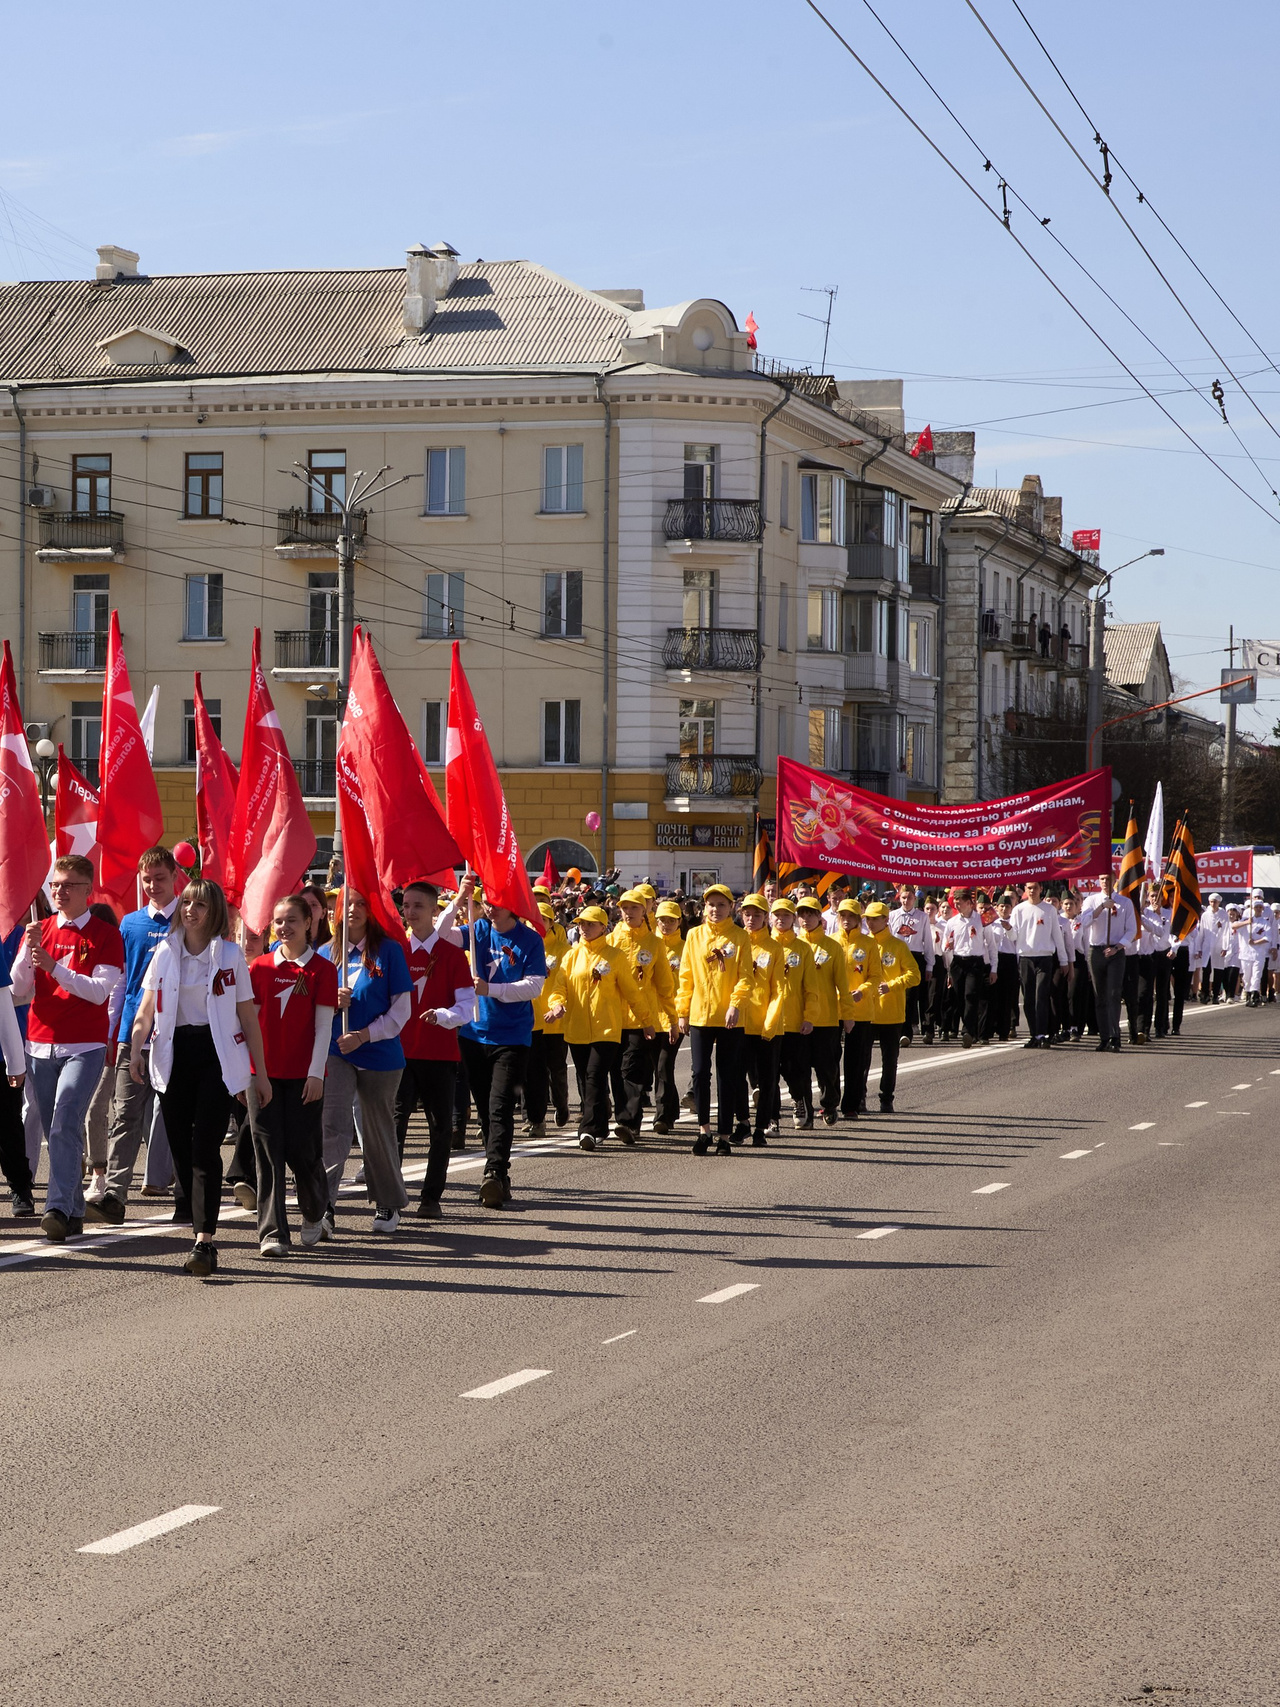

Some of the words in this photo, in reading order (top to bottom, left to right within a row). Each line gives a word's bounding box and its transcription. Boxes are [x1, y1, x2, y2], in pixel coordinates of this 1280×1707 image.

[986, 795, 1030, 810] города
[657, 824, 689, 834] ПОЧТА
[714, 825, 745, 836] ПОЧТА
[892, 824, 960, 838] гордостью
[964, 829, 979, 838] за
[983, 822, 1032, 836] Родину,
[657, 835, 691, 846] РОССИИ
[713, 837, 740, 847] БАНК
[892, 839, 984, 852] уверенностью
[988, 843, 995, 851] в
[999, 834, 1056, 851] будущем
[881, 854, 958, 868] продолжает
[962, 856, 1023, 868] эстафету
[1027, 848, 1071, 862] жизни.
[1197, 857, 1240, 869] быт,
[818, 853, 876, 870] Студенческий
[878, 867, 921, 877] коллектив
[923, 871, 1002, 879] Политехнического
[1004, 866, 1047, 877] техникума
[1197, 872, 1248, 883] быто!
